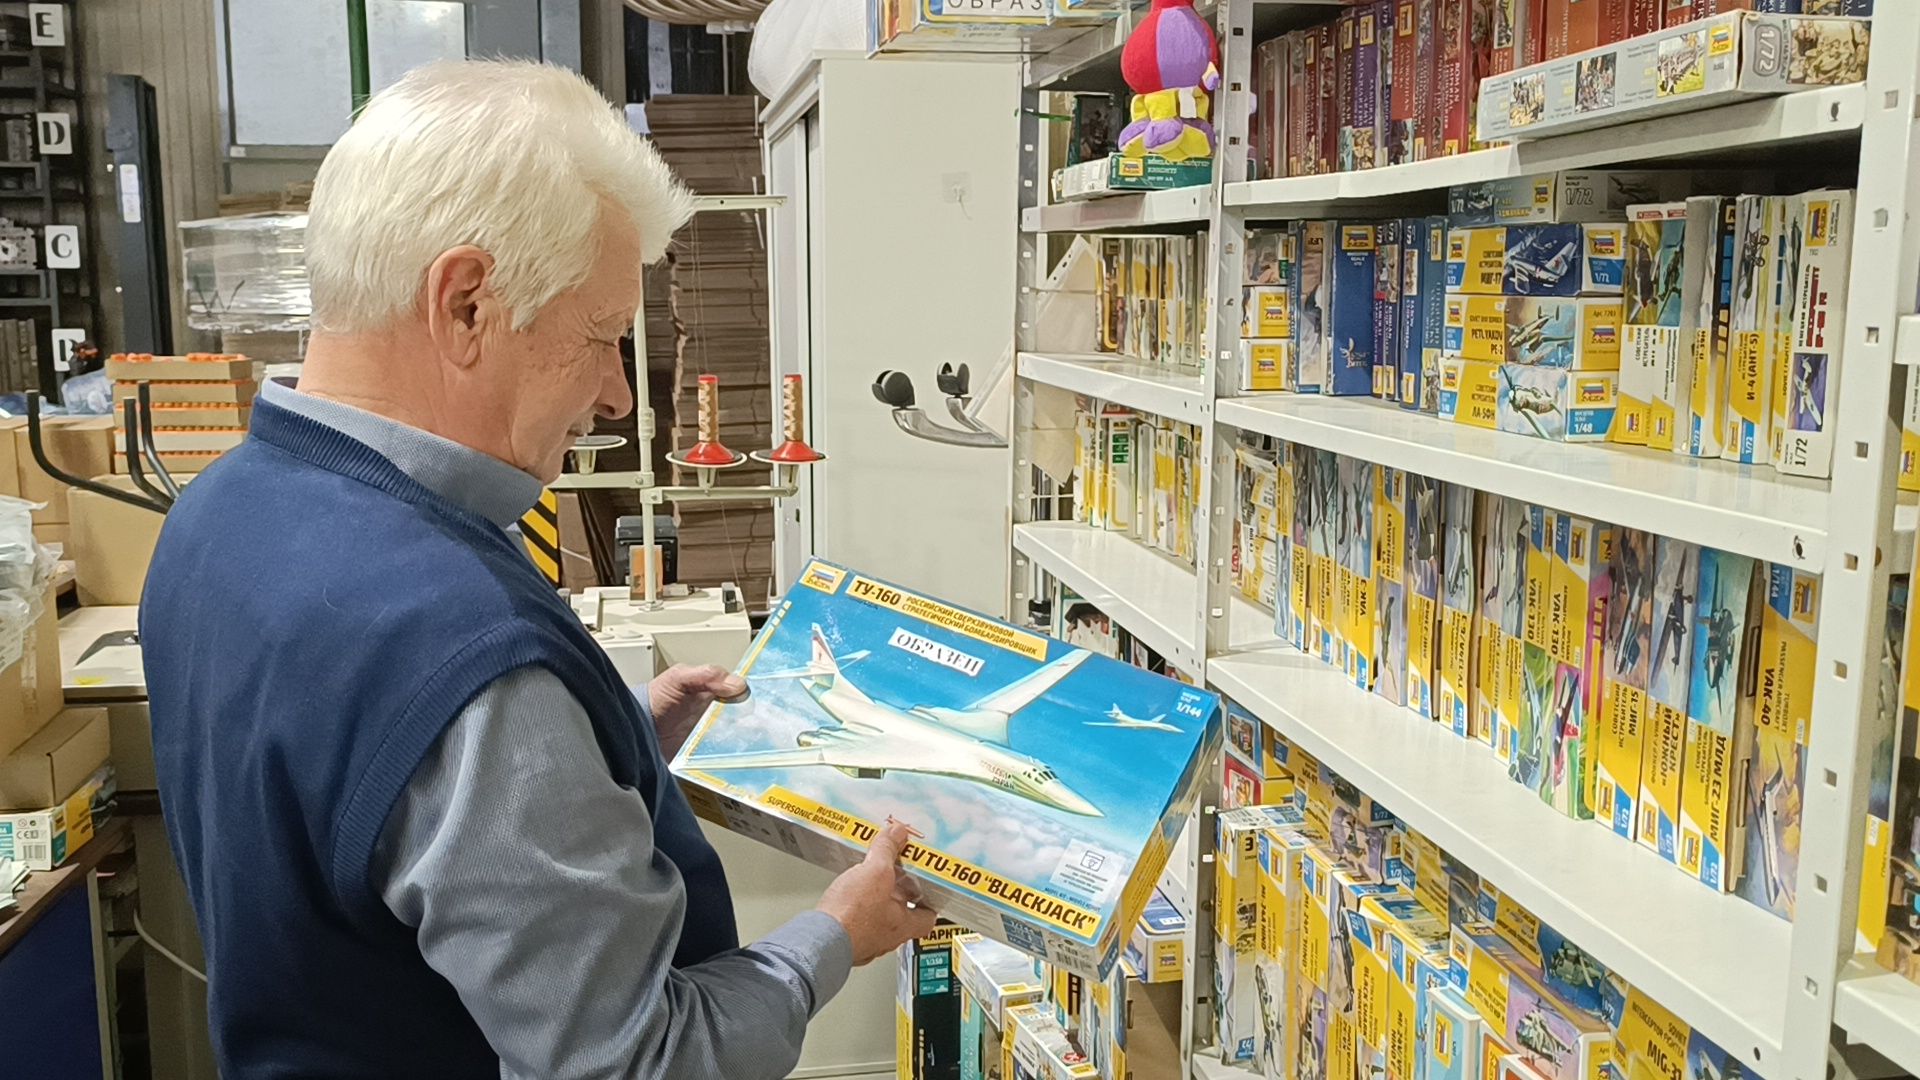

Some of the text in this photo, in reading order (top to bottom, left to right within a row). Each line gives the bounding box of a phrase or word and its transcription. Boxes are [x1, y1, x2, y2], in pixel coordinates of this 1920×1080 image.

[35, 12, 55, 38] E
[1760, 29, 1775, 71] 1/72
[43, 120, 65, 146] D
[1565, 188, 1594, 206] 1/72
[51, 233, 73, 259] C
[1747, 332, 1760, 401] И-4 (АНТ-5)
[1574, 422, 1593, 434] 1/48
[1796, 437, 1808, 467] 1/72
[853, 579, 902, 606] ТУ-160
[1359, 578, 1368, 617] YAK-3
[1770, 569, 1780, 598] 1/144
[906, 595, 1015, 638] РОССИЙСКИЙ СВЕРХЗВУКОВОЙ
[1526, 577, 1537, 641] YAK-130
[1550, 591, 1561, 656] YAK-130
[901, 603, 1038, 656] СТРАТЕГИЧЕСКИЙ БОМБАРДИРОВЩИК
[1760, 667, 1775, 726] YAK-40
[1773, 640, 1787, 731] PASSENGER AIRCRAFT
[1611, 683, 1621, 735] СОВЕТСКИЙ
[1618, 686, 1628, 748] ИСТРЕБИТЕЛЬ
[1627, 689, 1640, 737] МИГ-15
[1781, 692, 1790, 733] TURBOJET
[1659, 707, 1673, 786] «ЮЖНЫЙ
[1669, 712, 1681, 772] КРЕСТ»
[1709, 735, 1727, 841] МИГ-23 МЛД
[767, 795, 846, 833] SUPERSONIC BOMBER
[816, 805, 851, 825] RUSSIAN
[1620, 807, 1630, 830] 1/72
[850, 821, 927, 862] TUEV
[925, 852, 982, 887] TU-160
[1709, 861, 1719, 885] 1/72
[1362, 1002, 1370, 1037] SHARK
[1632, 1000, 1664, 1038] INTERCEPTOR
[1668, 1022, 1687, 1046] SOVIET
[1389, 1029, 1398, 1060] HIND
